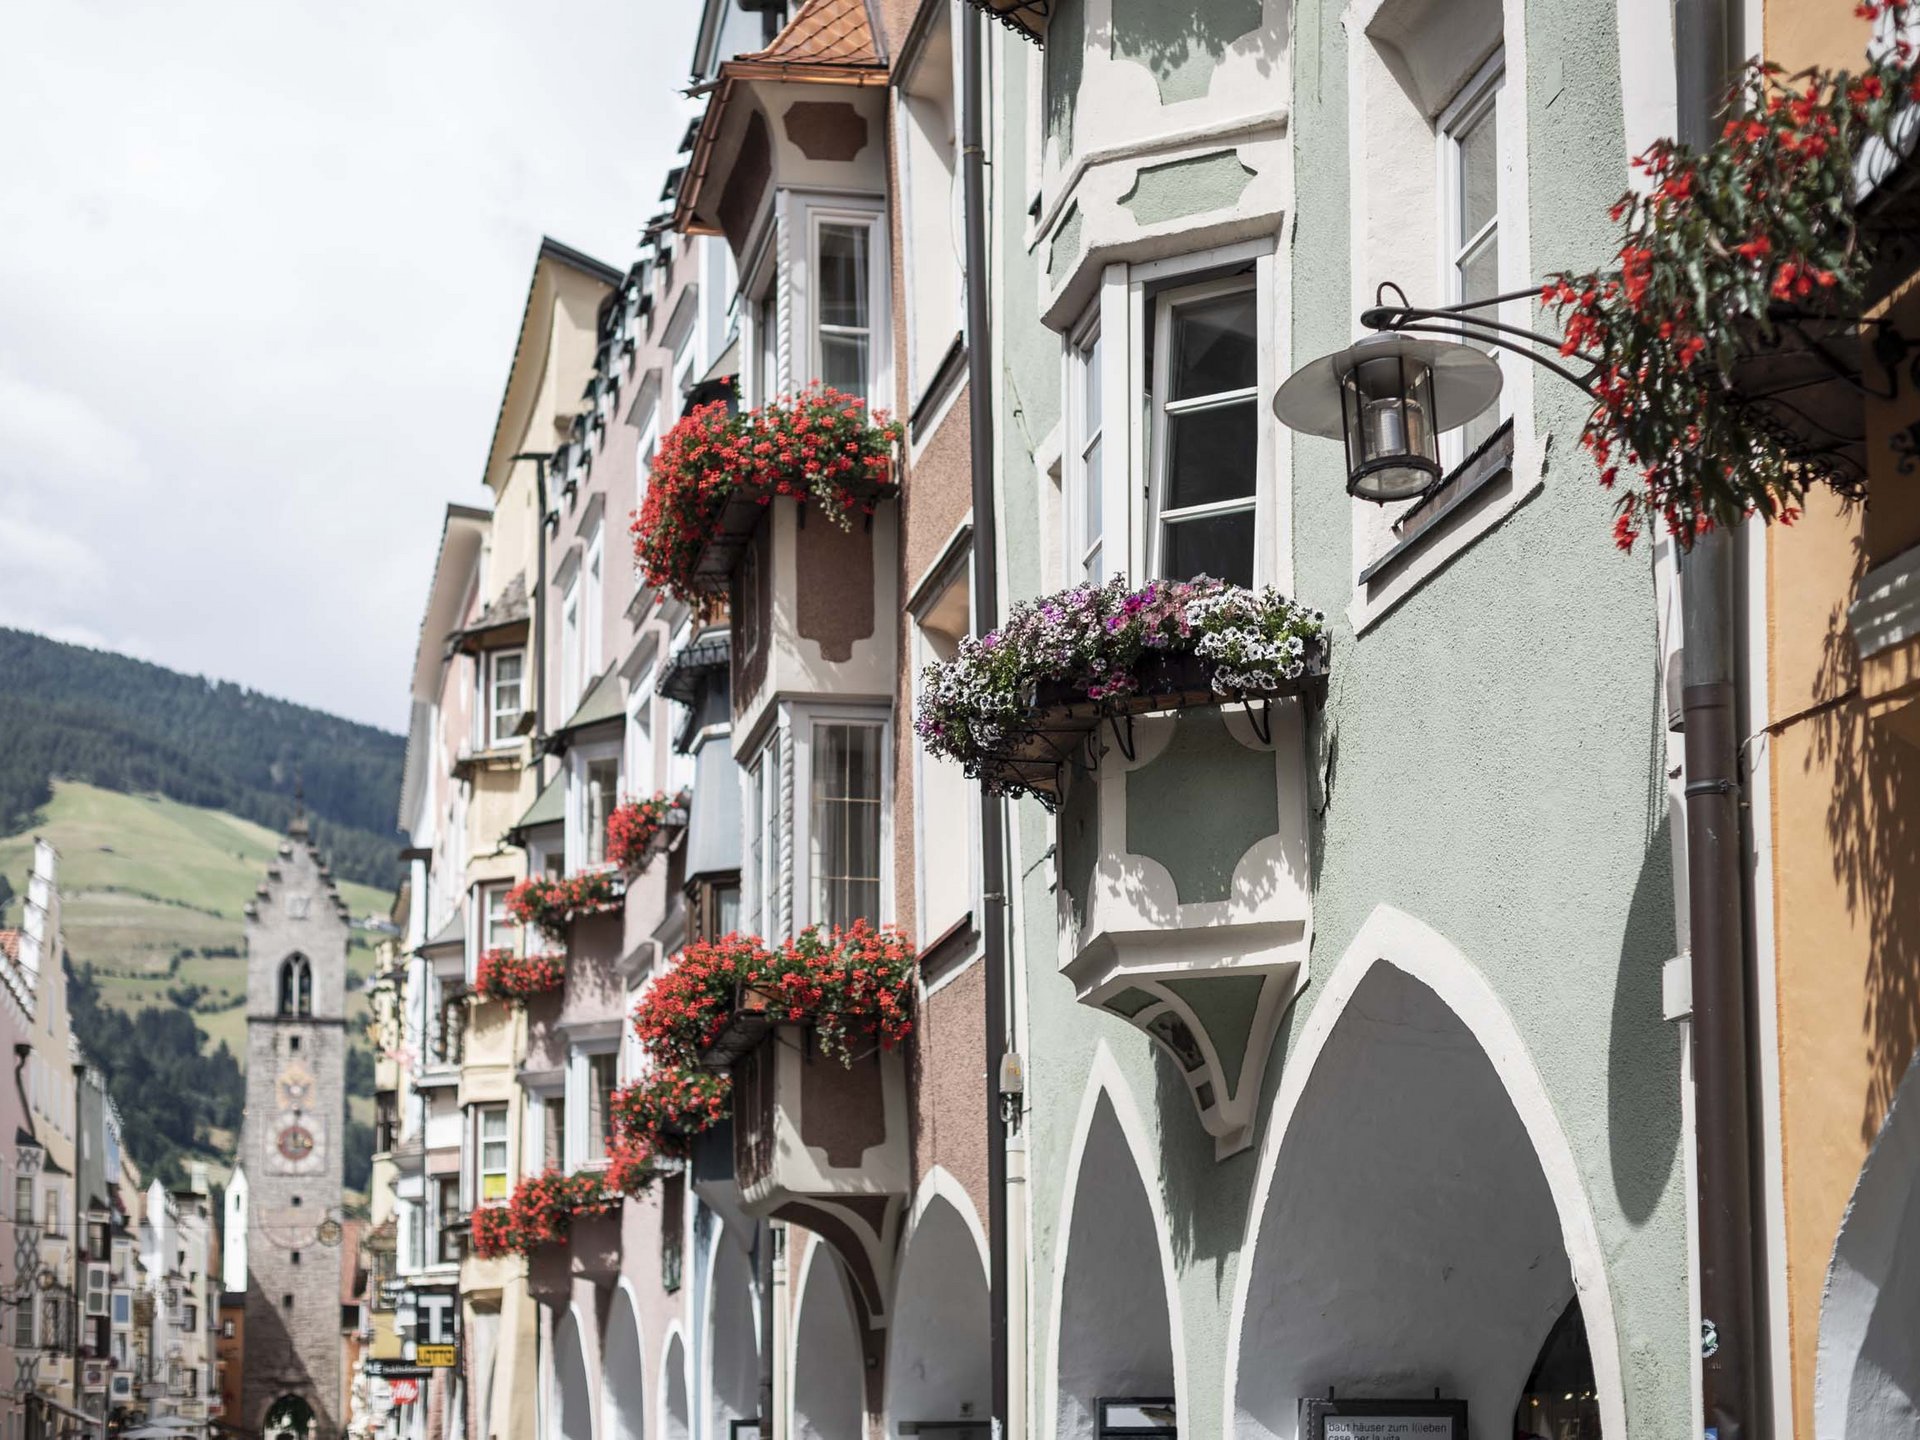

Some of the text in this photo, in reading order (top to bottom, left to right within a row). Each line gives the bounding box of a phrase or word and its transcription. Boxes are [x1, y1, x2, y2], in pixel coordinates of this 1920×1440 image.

[1328, 1422, 1350, 1432] baut
[1353, 1422, 1385, 1432] häuser
[1388, 1424, 1408, 1432] zum
